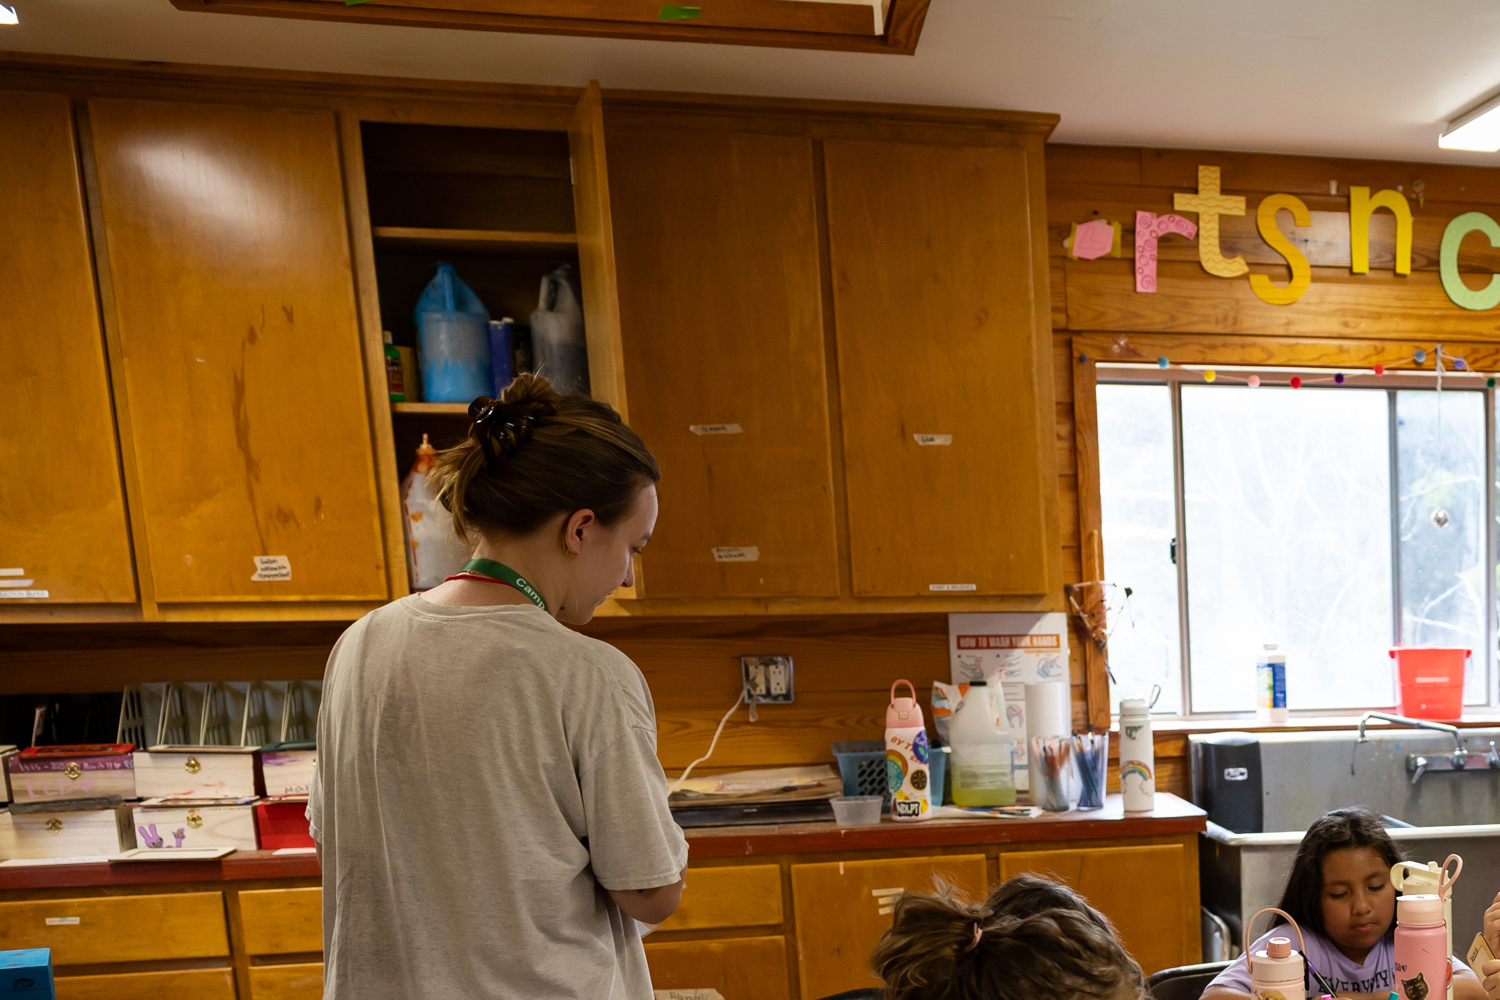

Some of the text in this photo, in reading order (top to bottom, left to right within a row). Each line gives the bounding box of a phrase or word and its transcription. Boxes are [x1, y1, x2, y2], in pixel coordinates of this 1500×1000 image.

[1350, 186, 1413, 275] n
[515, 578, 546, 611] Camp
[960, 635, 1058, 648] HOW TO WASH YOUR HANDS
